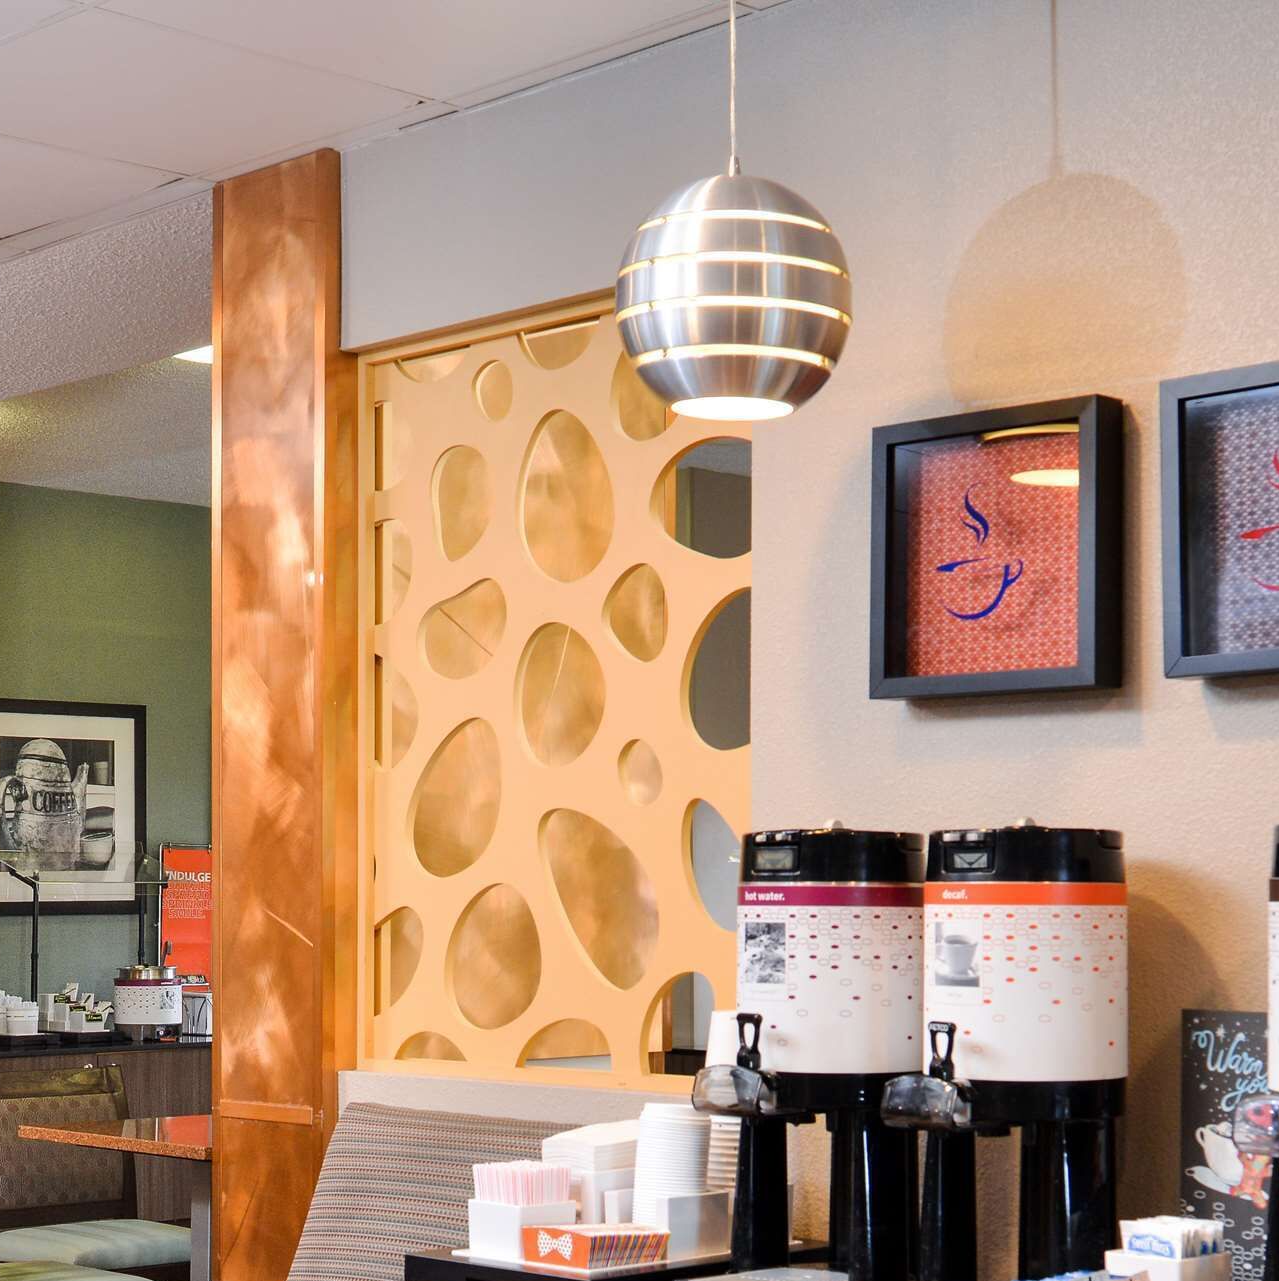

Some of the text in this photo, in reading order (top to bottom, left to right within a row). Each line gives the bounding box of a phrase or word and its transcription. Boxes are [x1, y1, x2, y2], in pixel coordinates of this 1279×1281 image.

[745, 891, 785, 900] hot water.
[942, 889, 968, 900] decaf.
